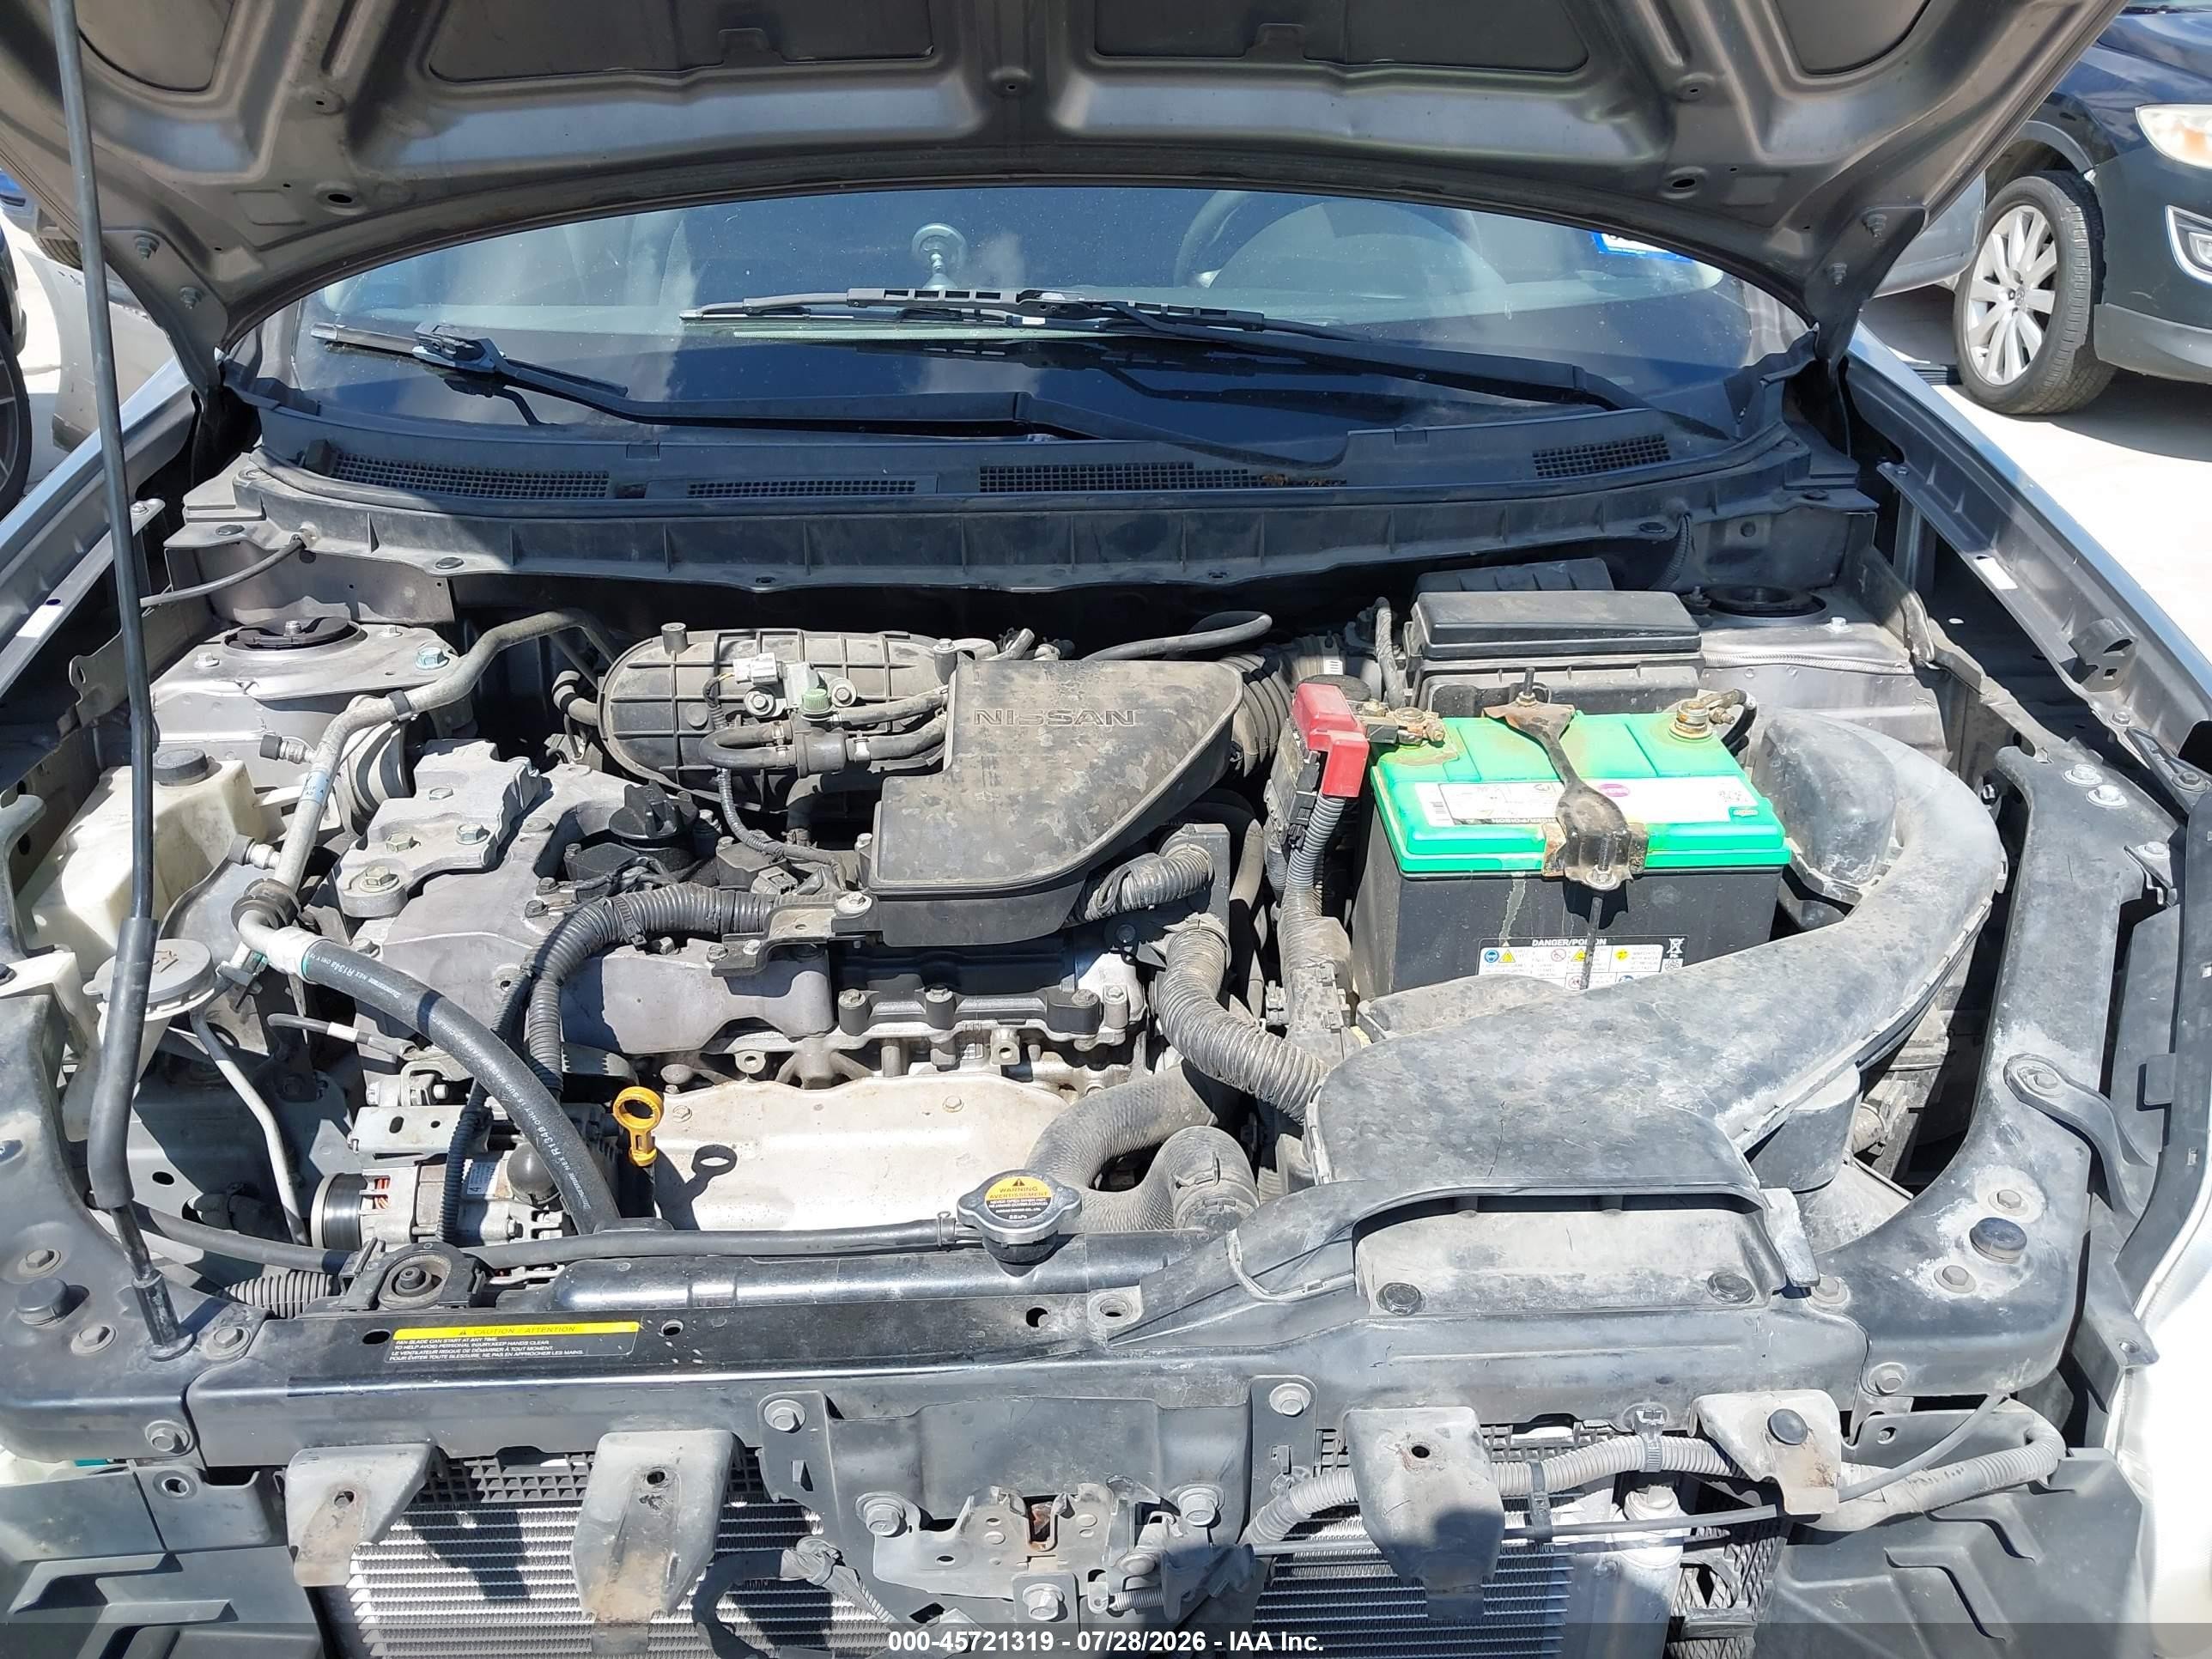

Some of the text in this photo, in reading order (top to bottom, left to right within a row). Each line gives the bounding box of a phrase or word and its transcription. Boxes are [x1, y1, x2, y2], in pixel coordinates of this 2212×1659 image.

[974, 708, 1134, 726] NISSAN
[1532, 938, 1607, 946] DANGER/POION
[524, 1107, 542, 1127] ONLY
[474, 1327, 514, 1335] CAUTION
